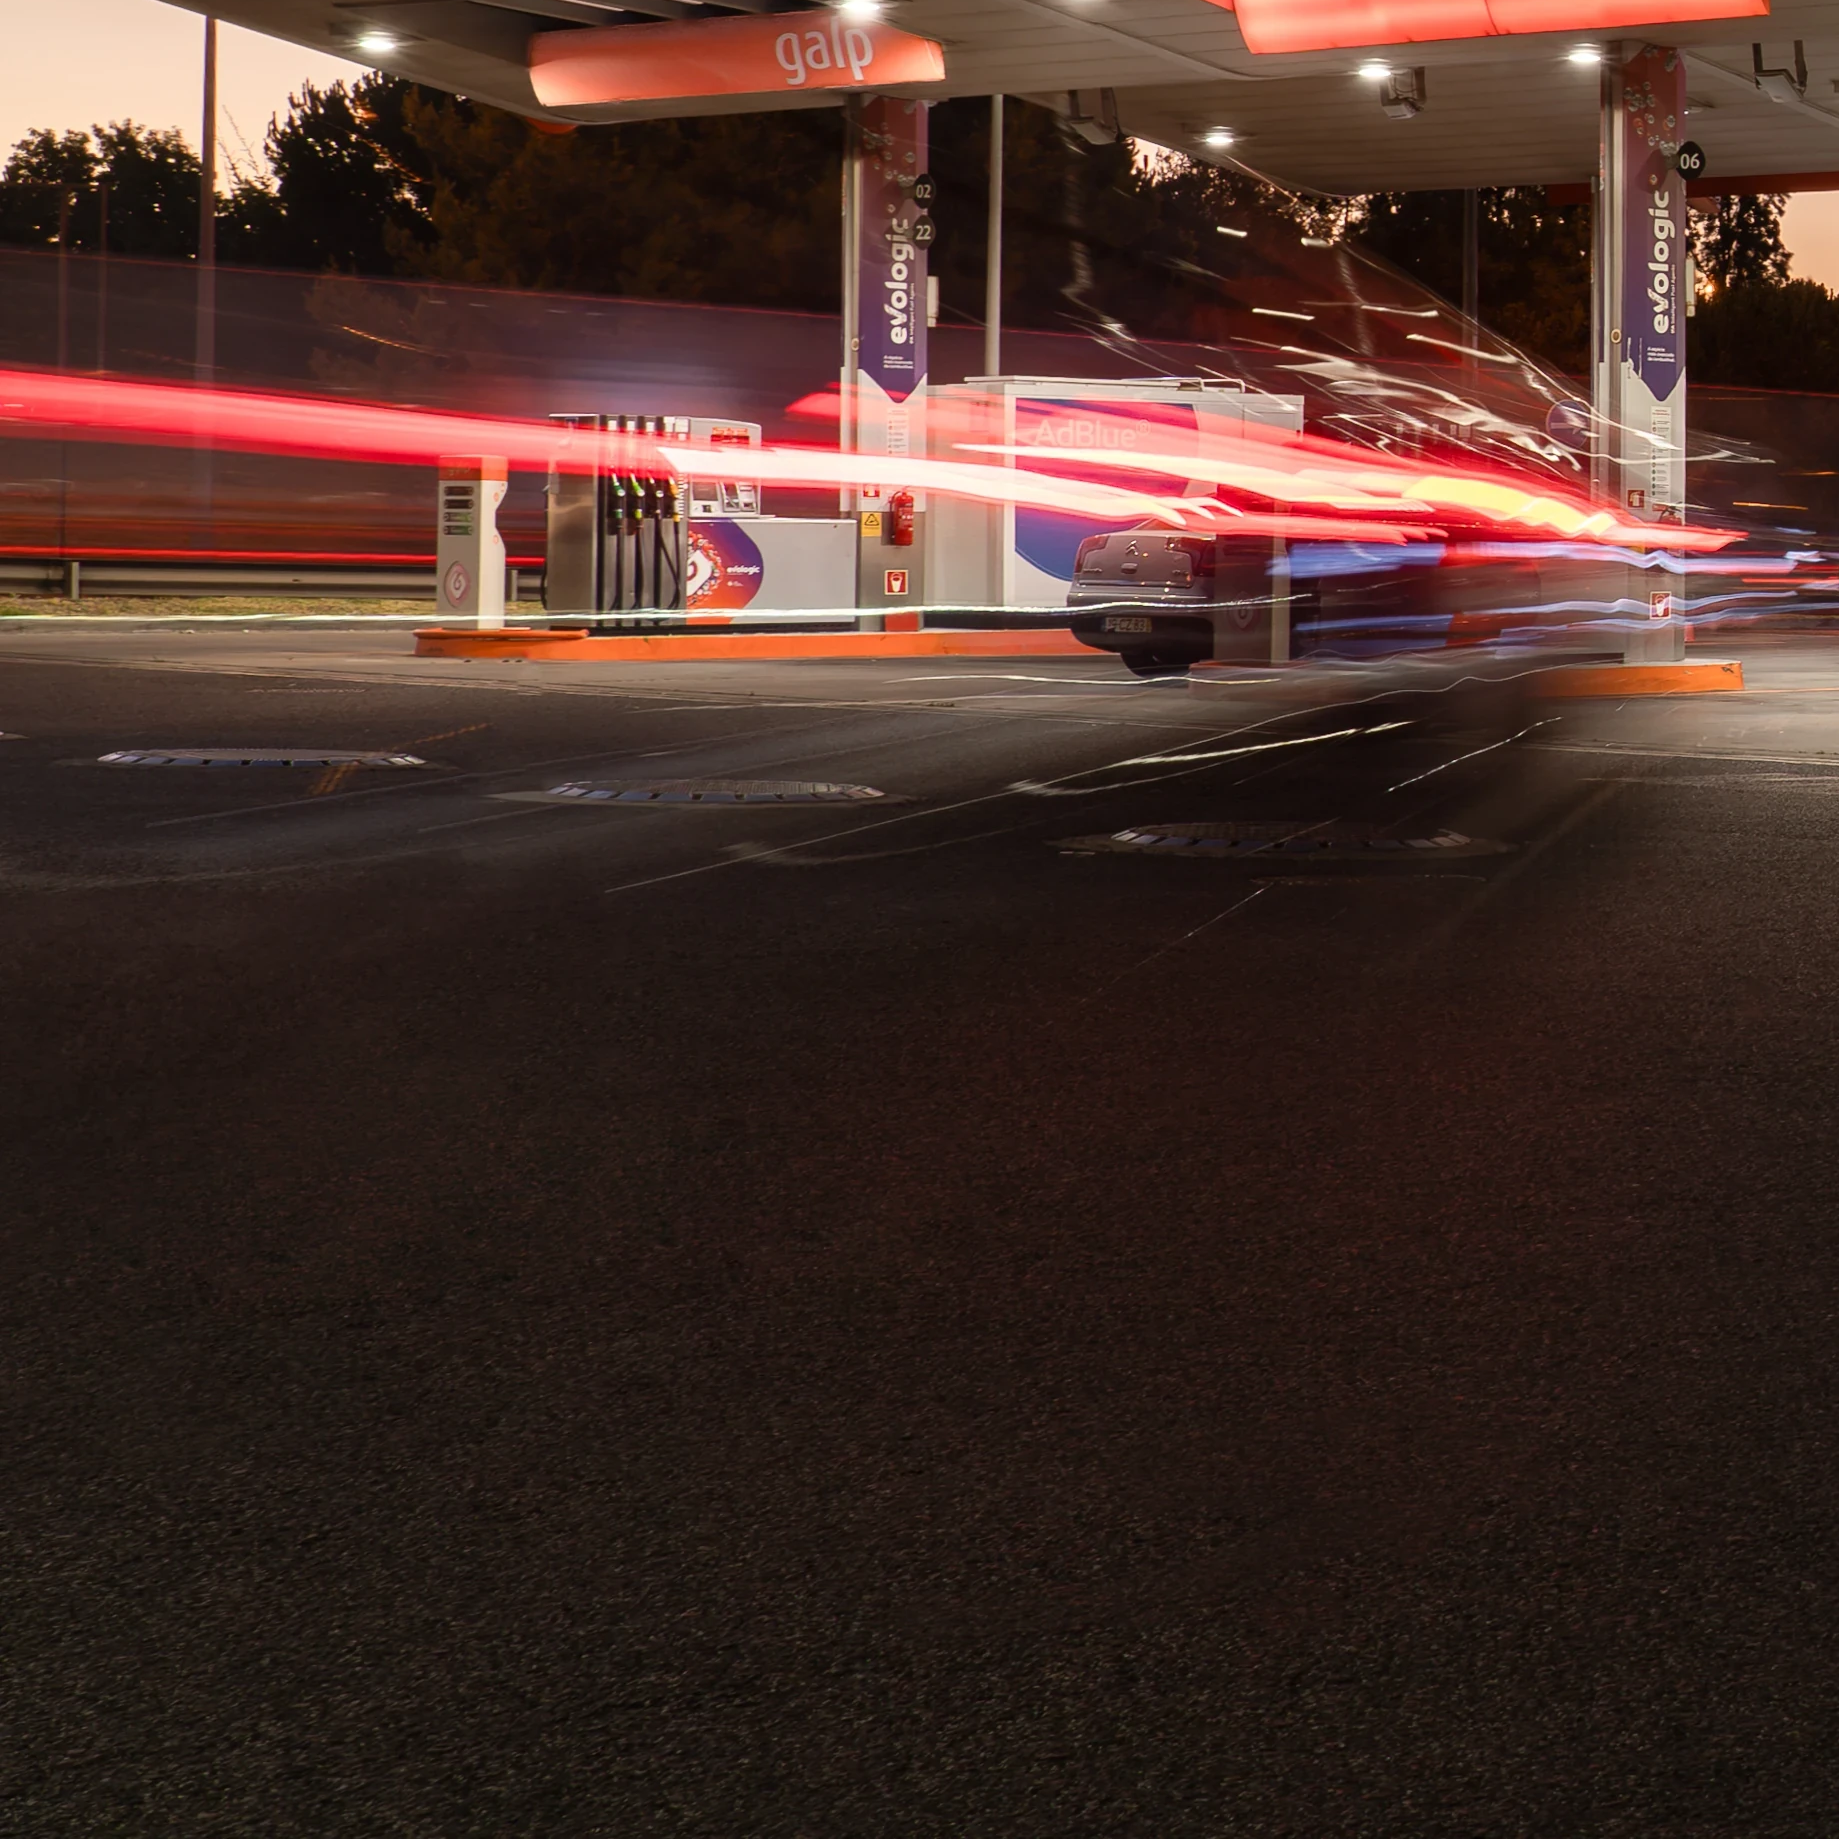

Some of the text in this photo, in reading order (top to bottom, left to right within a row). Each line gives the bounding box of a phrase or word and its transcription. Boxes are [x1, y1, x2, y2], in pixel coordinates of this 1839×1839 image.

[775, 16, 873, 85] galp
[1680, 153, 1700, 170] 06
[916, 184, 931, 198] 02
[916, 224, 931, 240] 22
[884, 218, 915, 344] evologic
[1648, 190, 1675, 334] evologic
